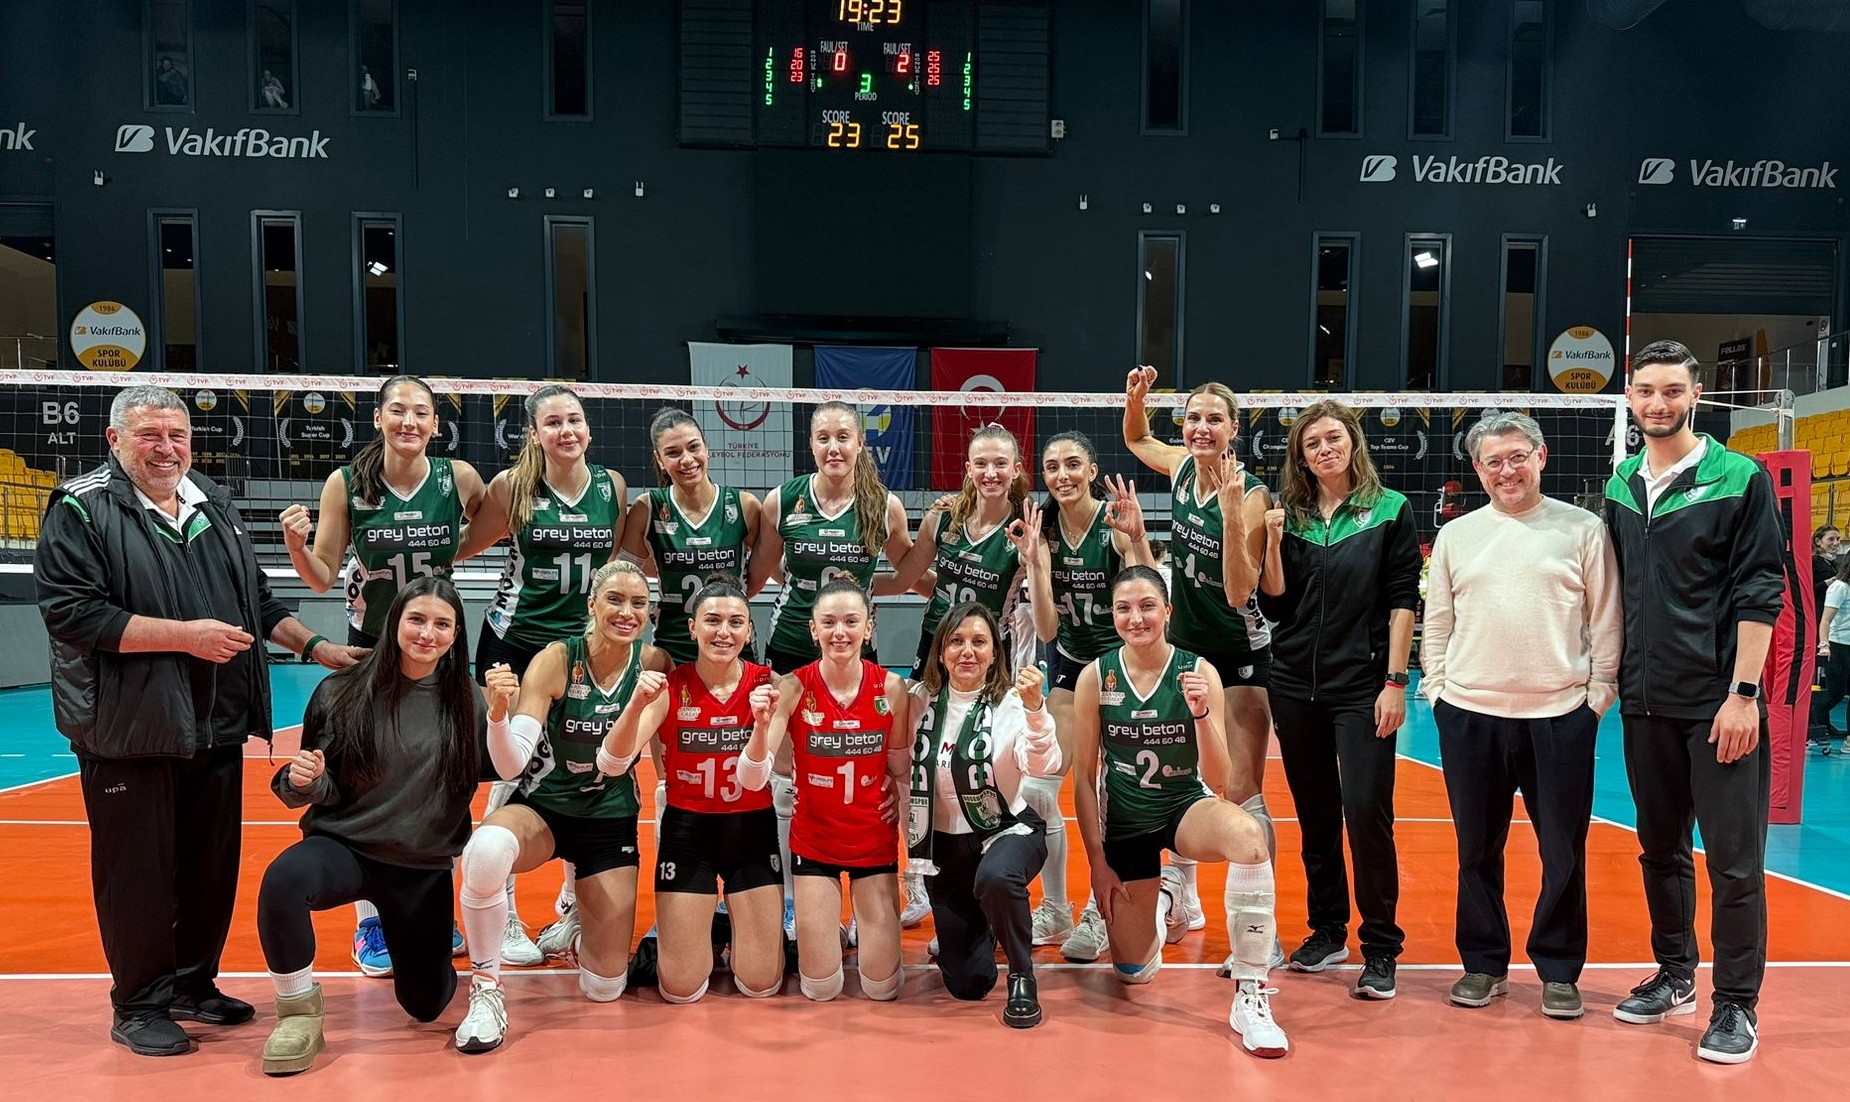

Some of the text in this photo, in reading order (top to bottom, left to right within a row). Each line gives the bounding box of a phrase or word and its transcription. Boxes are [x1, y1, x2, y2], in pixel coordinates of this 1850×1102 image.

[857, 22, 874, 31] TIME
[820, 41, 848, 53] FAUL/SET
[883, 43, 911, 55] FAUL/SET
[765, 58, 773, 69] 2
[791, 60, 803, 70] 20
[834, 52, 846, 71] 0
[897, 54, 909, 73] 2
[928, 63, 940, 73] 25
[963, 63, 971, 74] 2
[765, 70, 773, 81] 3
[791, 72, 803, 82] 23
[928, 75, 940, 85] 25
[964, 75, 971, 86] 3
[860, 74, 871, 93] 3
[854, 92, 877, 101] PERIOD
[822, 110, 850, 124] SCORE
[882, 111, 910, 125] SCORE
[828, 122, 860, 147] 23
[888, 124, 919, 149] 25
[165, 127, 331, 158] VakıfBank
[1412, 154, 1564, 185] VakıfBank
[1690, 158, 1840, 189] VakıfBank
[90, 326, 141, 337] VakıfBank
[1573, 329, 1590, 338] 1986
[97, 349, 121, 358] SPOR
[1564, 349, 1611, 360] VakıfBank
[1570, 372, 1592, 381] SPOR
[42, 401, 80, 425] B6
[47, 432, 77, 445] ALT
[367, 524, 450, 542] grey beton
[533, 527, 613, 541] grey beton
[1190, 528, 1220, 550] beton
[794, 542, 826, 555] grey
[664, 549, 735, 564] grey beton
[387, 552, 433, 593] 15
[553, 552, 592, 594] 11
[939, 556, 1000, 582] grey beton
[1071, 569, 1105, 581] beton
[1060, 592, 1094, 627] 17
[565, 718, 603, 735] grey
[1108, 722, 1185, 738] grey beton
[681, 731, 718, 745] grey
[809, 731, 883, 748] grey beton
[1143, 738, 1160, 746] 444
[1135, 750, 1162, 790] 2
[696, 756, 743, 802] 13
[836, 760, 855, 805] 1
[659, 861, 676, 881] 13
